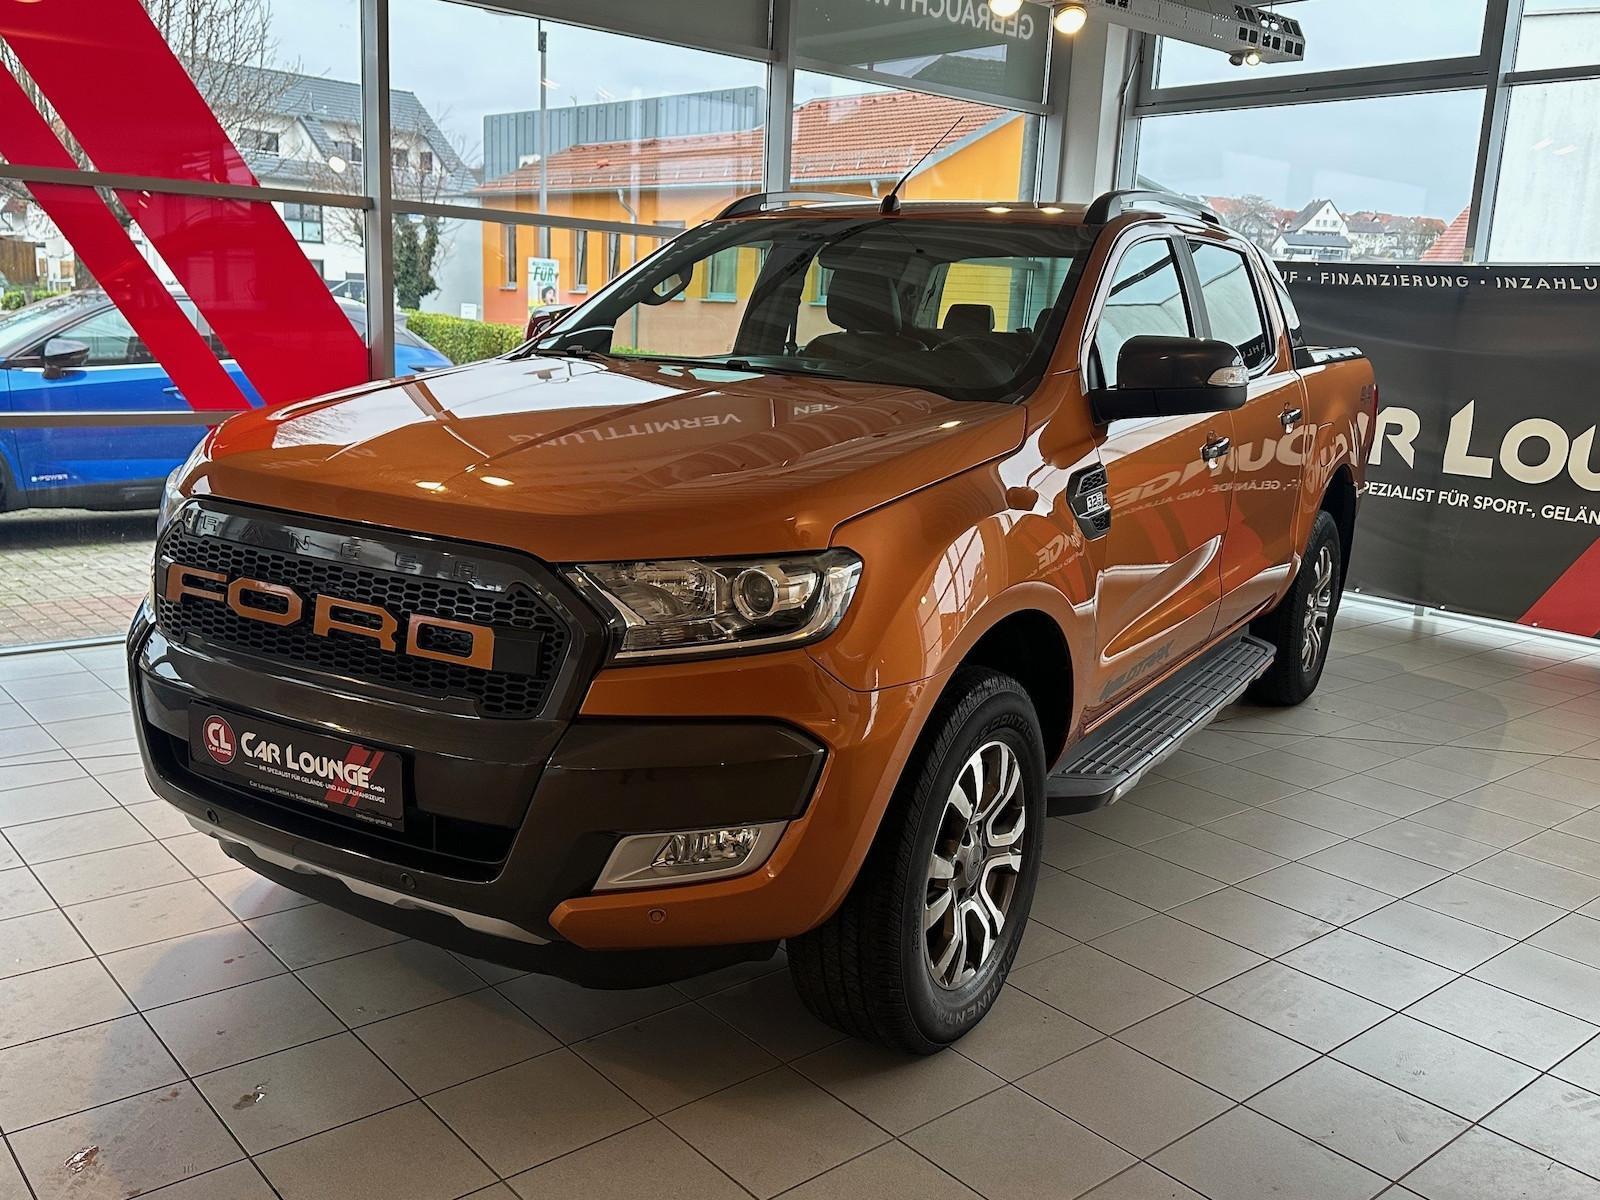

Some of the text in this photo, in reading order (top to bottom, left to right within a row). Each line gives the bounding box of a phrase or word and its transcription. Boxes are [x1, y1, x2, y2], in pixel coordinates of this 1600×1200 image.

[533, 266, 554, 281] FÜR
[1320, 271, 1469, 288] FINANZIERUNG
[1495, 276, 1598, 291] INZAHLU
[1438, 489, 1469, 507] FÜR
[1473, 495, 1536, 518] SPORT-,
[201, 510, 480, 577] RANGER
[166, 563, 495, 671] FORD
[207, 722, 232, 751] CL
[240, 731, 281, 765] CAR
[286, 743, 373, 789] LOUNGE
[291, 773, 301, 782] FÜR
[326, 784, 337, 792] UND
